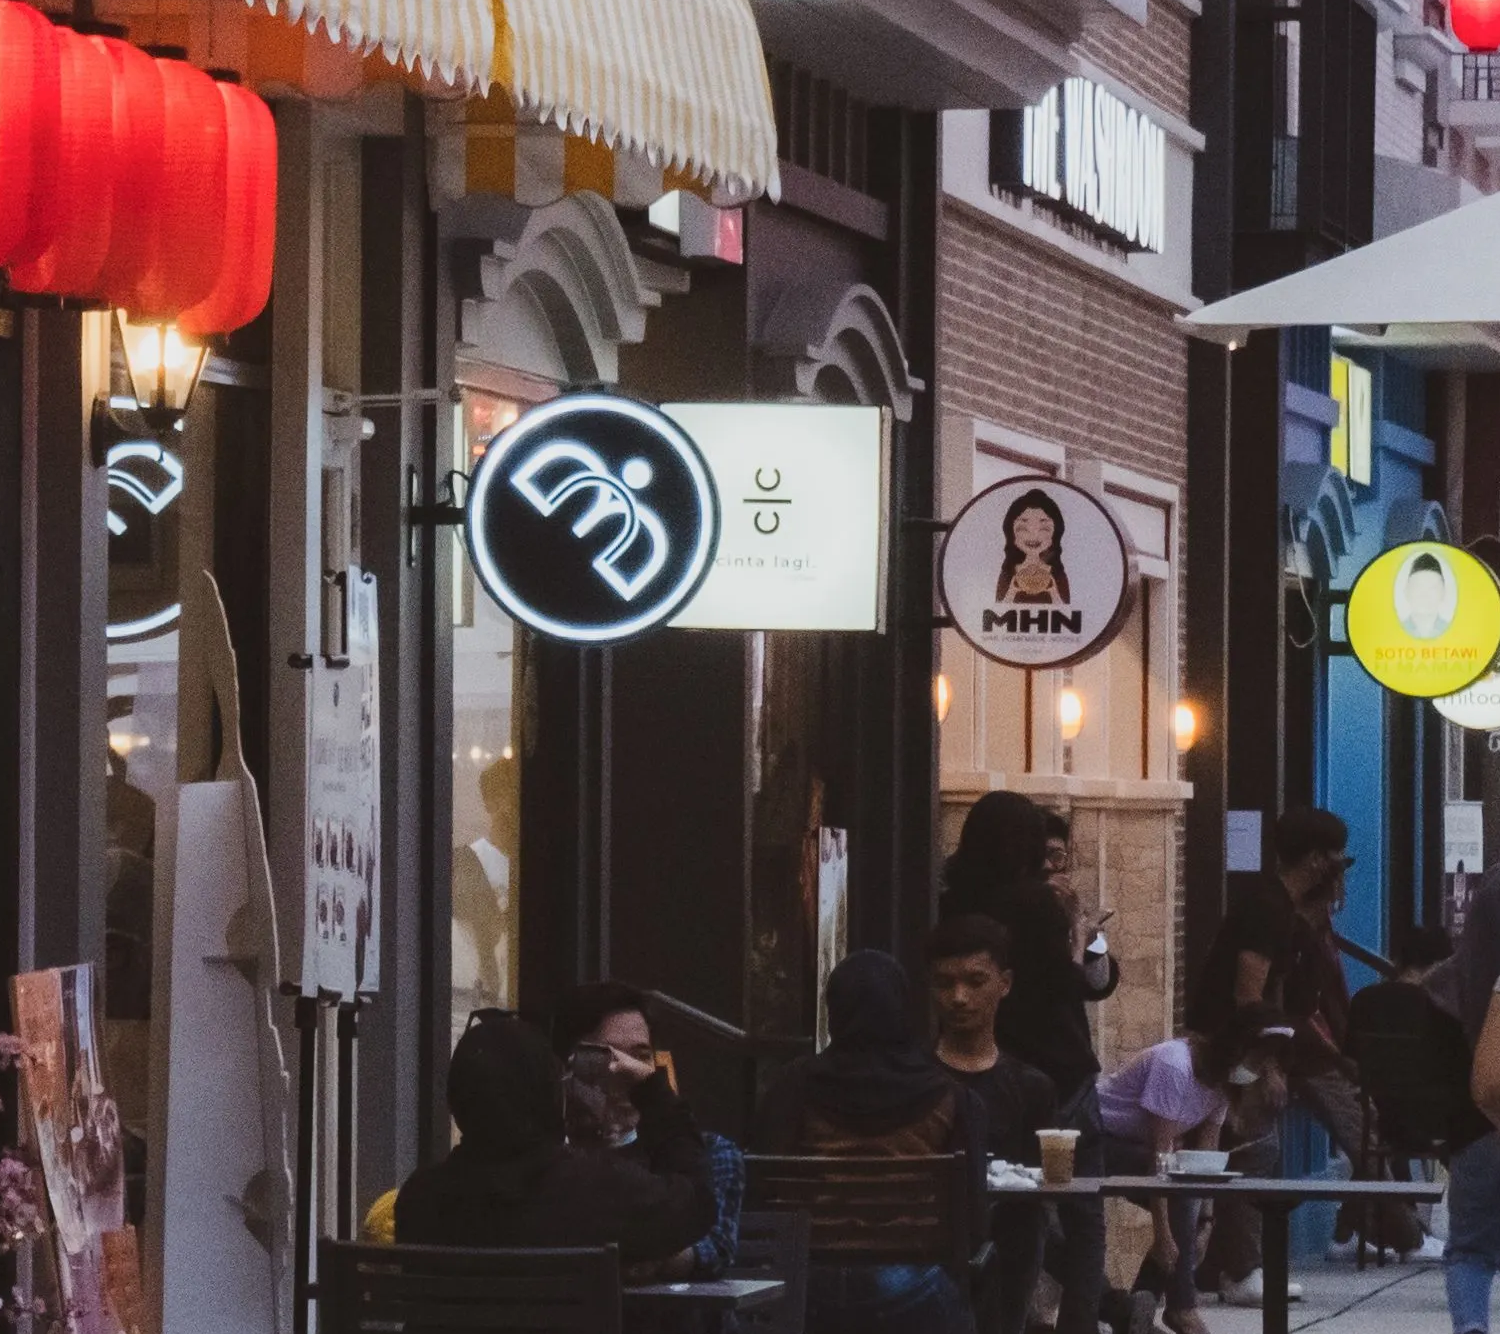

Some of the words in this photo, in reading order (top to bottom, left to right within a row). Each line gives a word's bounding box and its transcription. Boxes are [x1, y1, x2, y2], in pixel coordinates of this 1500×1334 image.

[716, 555, 765, 567] cinta
[982, 608, 1082, 634] MHN
[1375, 647, 1416, 660] SOTO
[1421, 647, 1478, 660] BETAWI
